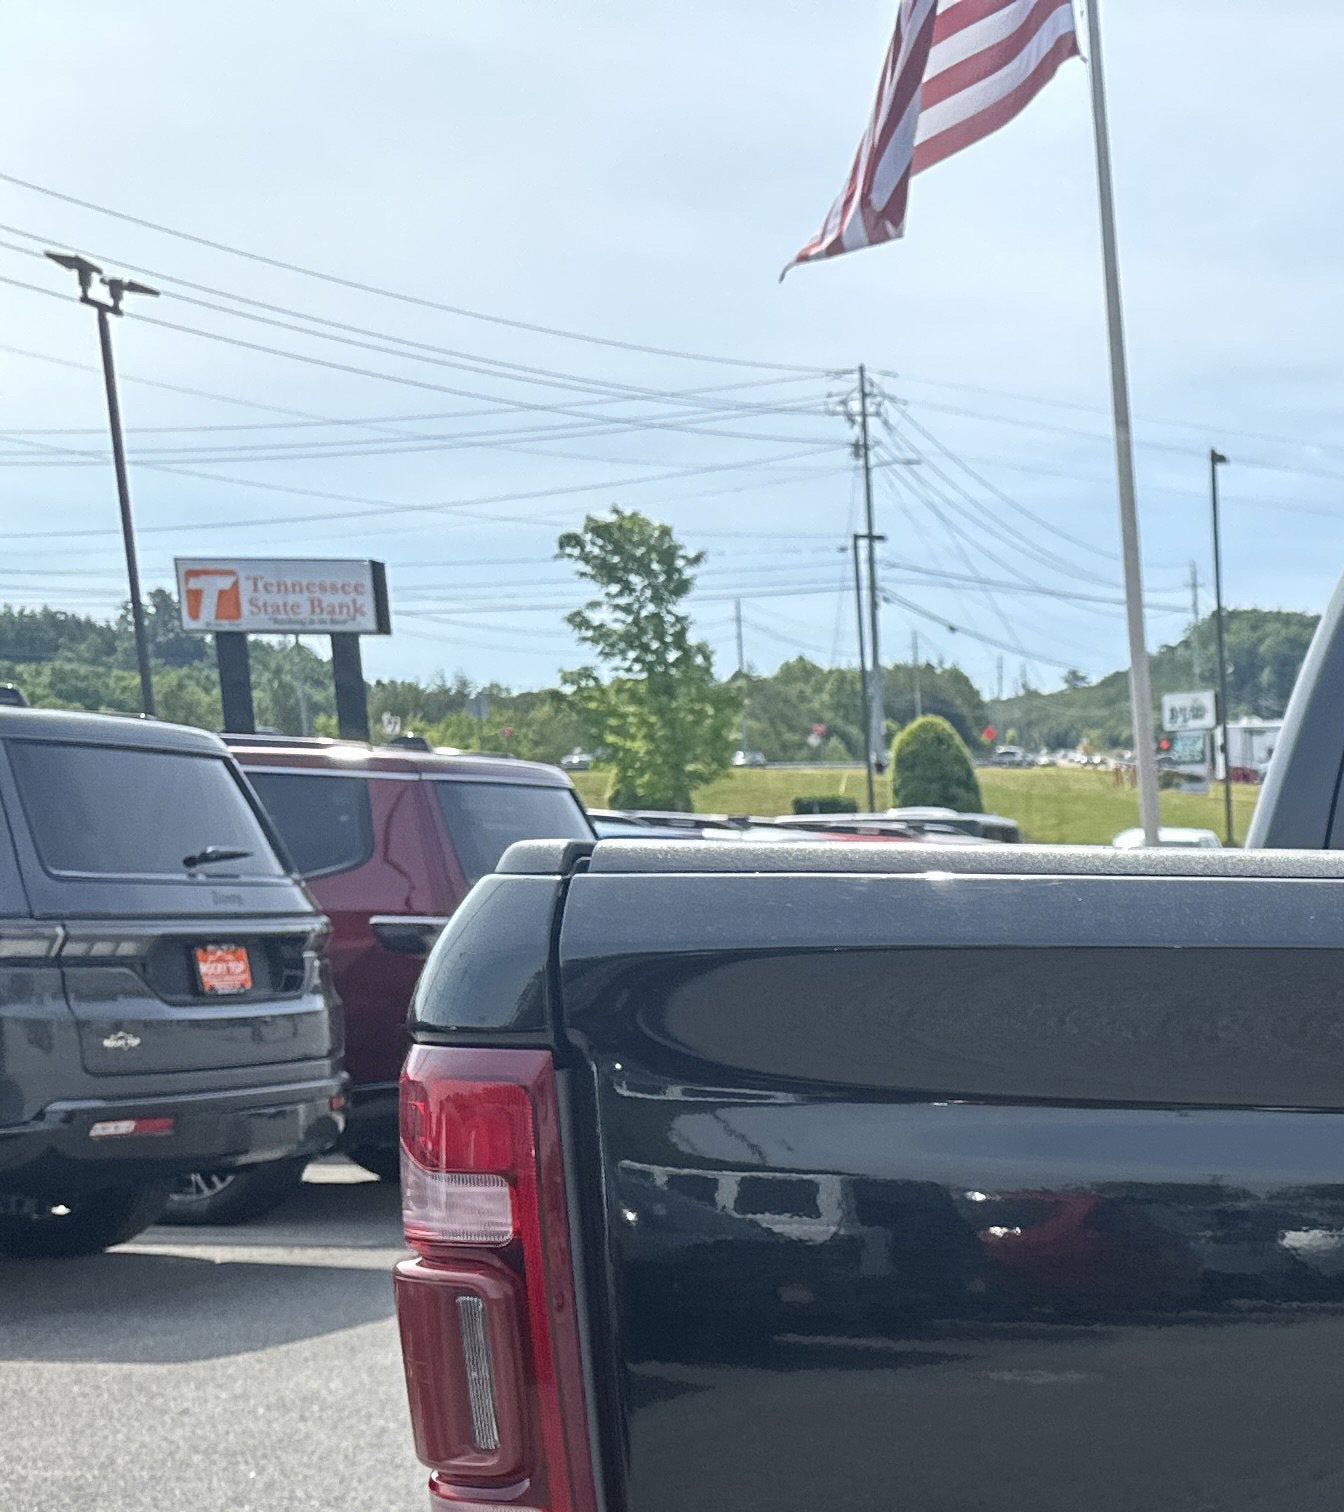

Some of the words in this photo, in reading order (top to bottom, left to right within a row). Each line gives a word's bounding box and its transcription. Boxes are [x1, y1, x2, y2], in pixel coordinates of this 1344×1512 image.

[246, 575, 365, 596] Tennessee
[249, 597, 302, 615] State
[308, 597, 366, 617] Bank
